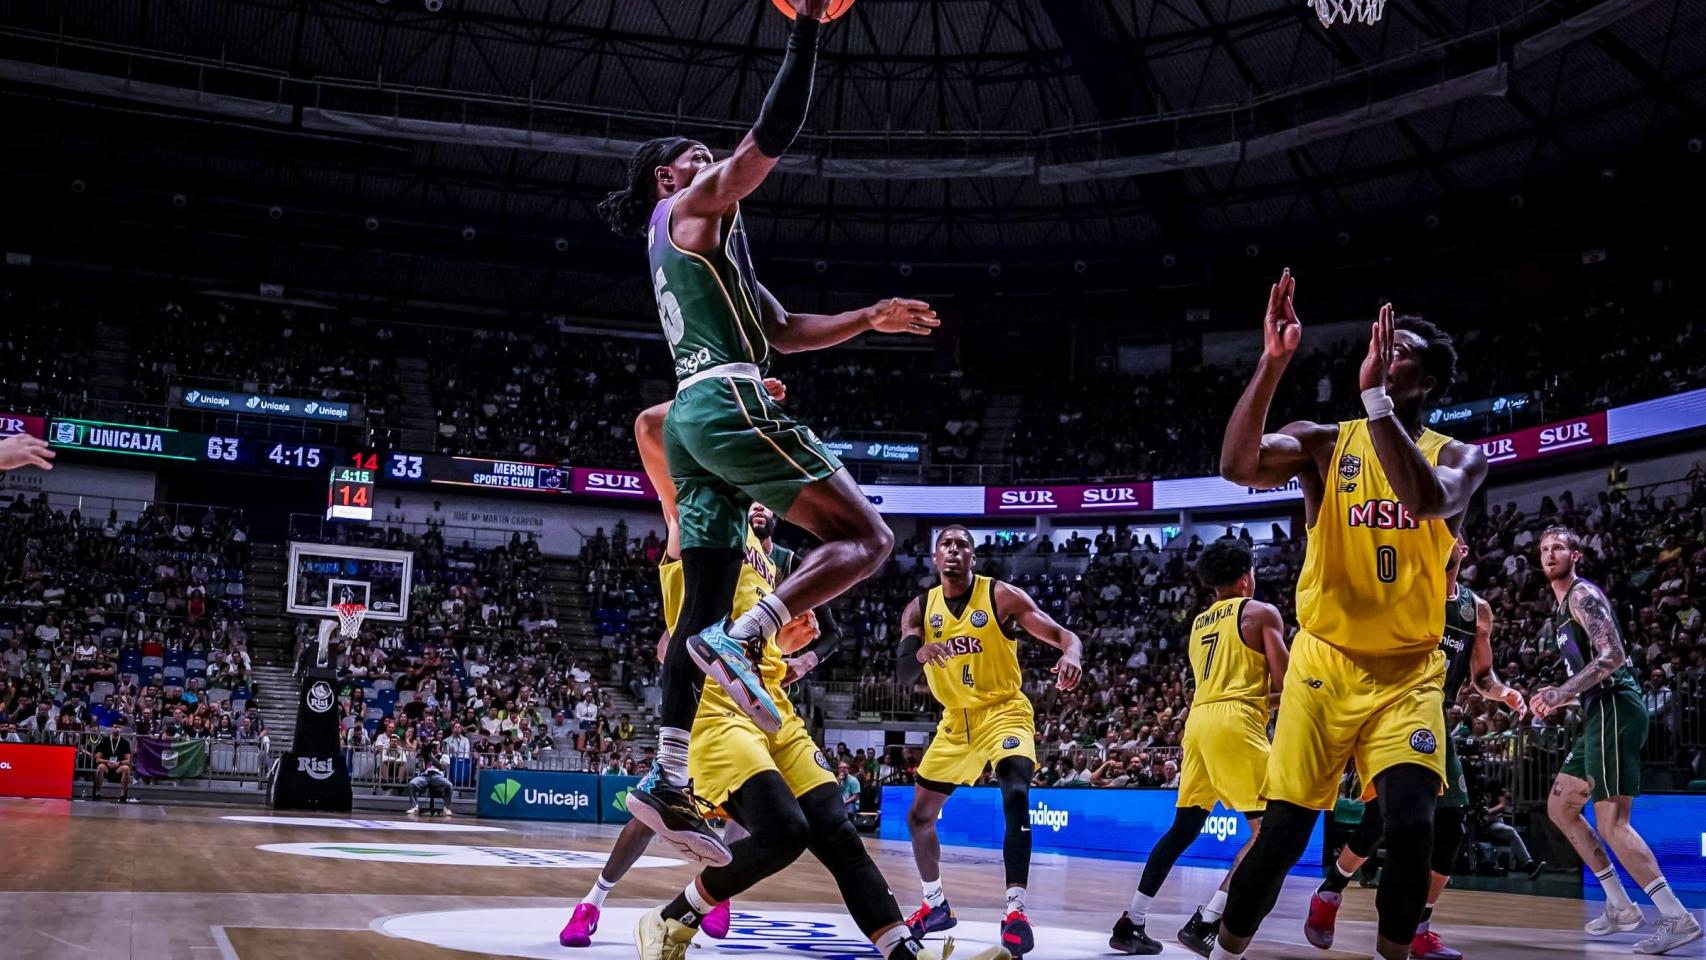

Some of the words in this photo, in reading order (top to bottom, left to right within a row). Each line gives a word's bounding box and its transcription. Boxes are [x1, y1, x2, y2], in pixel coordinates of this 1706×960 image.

[200, 395, 230, 406] Unicaja
[260, 401, 290, 412] Unicaja
[318, 406, 348, 417] Unicaja
[89, 427, 163, 452] UNICAJA
[1539, 421, 1590, 446] SUR
[207, 436, 239, 461] 63
[268, 443, 321, 468] 4:15
[883, 451, 909, 459] Unicaja
[1479, 438, 1515, 457] UR
[352, 452, 379, 470] 14
[391, 454, 423, 479] 33
[493, 463, 535, 477] MERSIN
[1340, 465, 1359, 474] MSK
[341, 469, 369, 482] 4:15
[473, 473, 509, 486] SPORTS
[511, 476, 534, 488] CLUB
[587, 473, 641, 489] SUR
[339, 485, 368, 507] 14
[1001, 490, 1054, 504] SUR
[1083, 487, 1135, 502] SUR
[1377, 545, 1396, 583] 0
[1195, 610, 1221, 631] COWAN
[1201, 632, 1219, 681] 7
[962, 664, 975, 688] 4
[1564, 658, 1574, 677] 2
[297, 757, 333, 772] Risi
[524, 788, 589, 810] Unicaja
